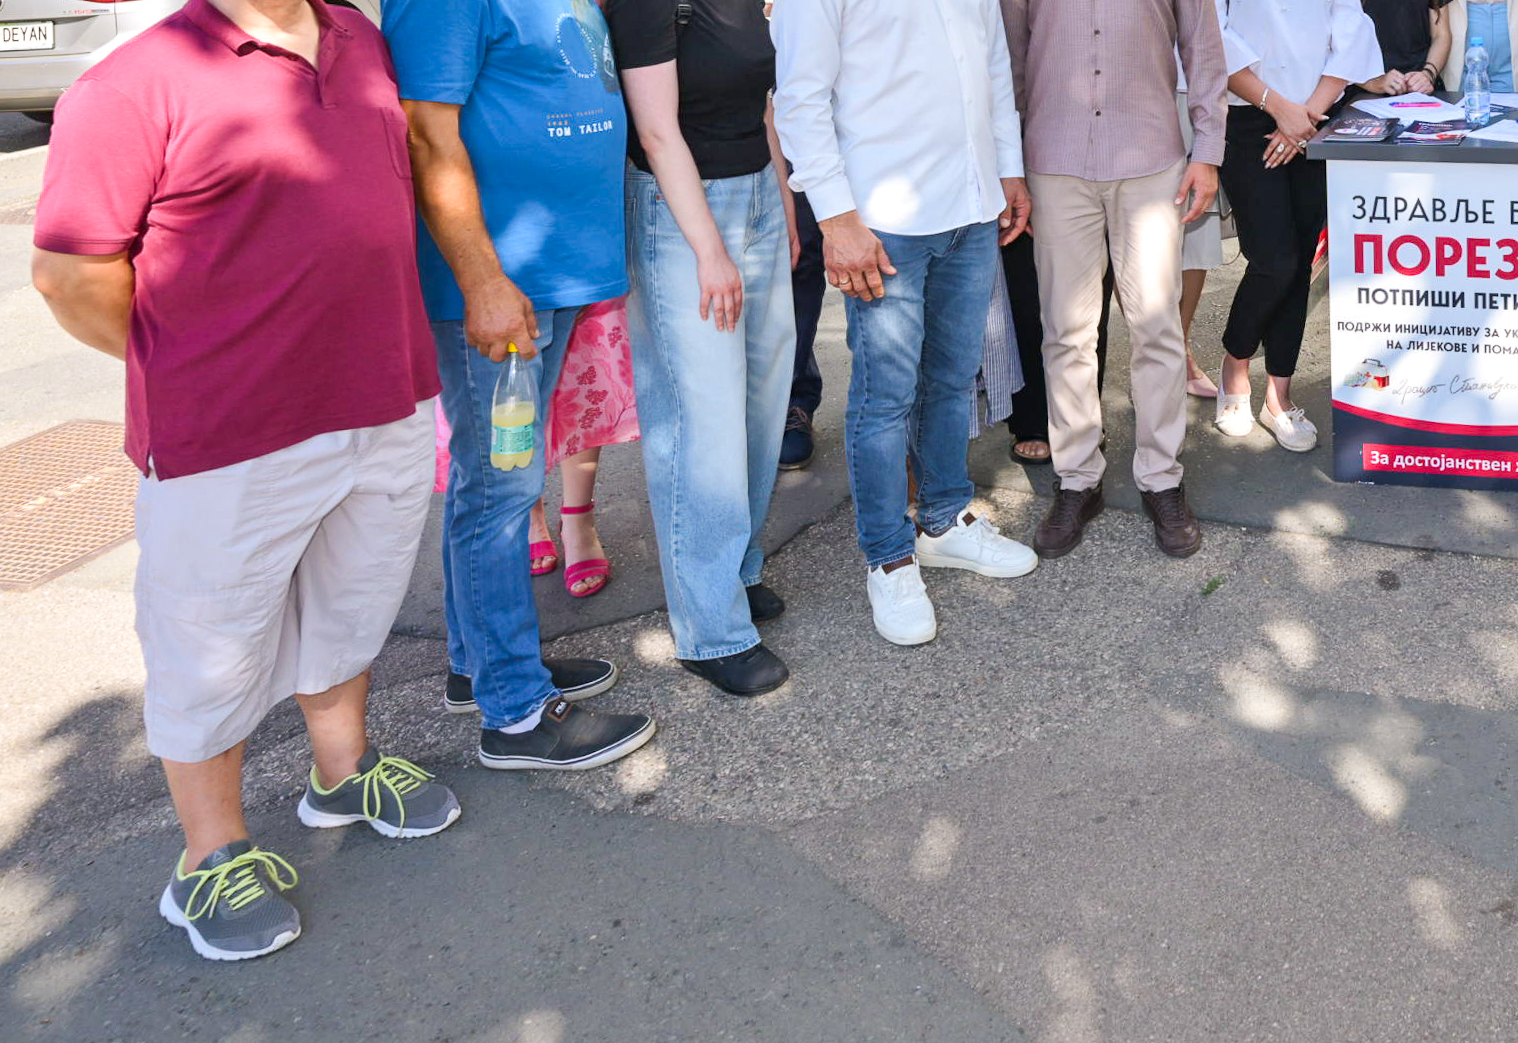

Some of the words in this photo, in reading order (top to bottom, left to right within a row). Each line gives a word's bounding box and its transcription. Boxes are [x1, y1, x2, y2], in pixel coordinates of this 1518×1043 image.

[3, 26, 47, 42] DEYAN
[547, 126, 571, 137] TOM
[579, 120, 613, 134] TAILOR
[1352, 195, 1495, 224] ЗДРАВЉЕ
[1357, 287, 1465, 308] ПОТПИШИ
[1337, 321, 1391, 333] ПОДРЖИ
[1395, 323, 1480, 337] ИНИЦИЈАТИВУ
[1484, 329, 1499, 338] ЗА
[1386, 340, 1402, 350] НА
[1407, 340, 1468, 353] ЛИЈЕКОВЕ
[1471, 344, 1480, 353] И
[1370, 451, 1389, 464] За
[1393, 454, 1511, 471] достојанствен
